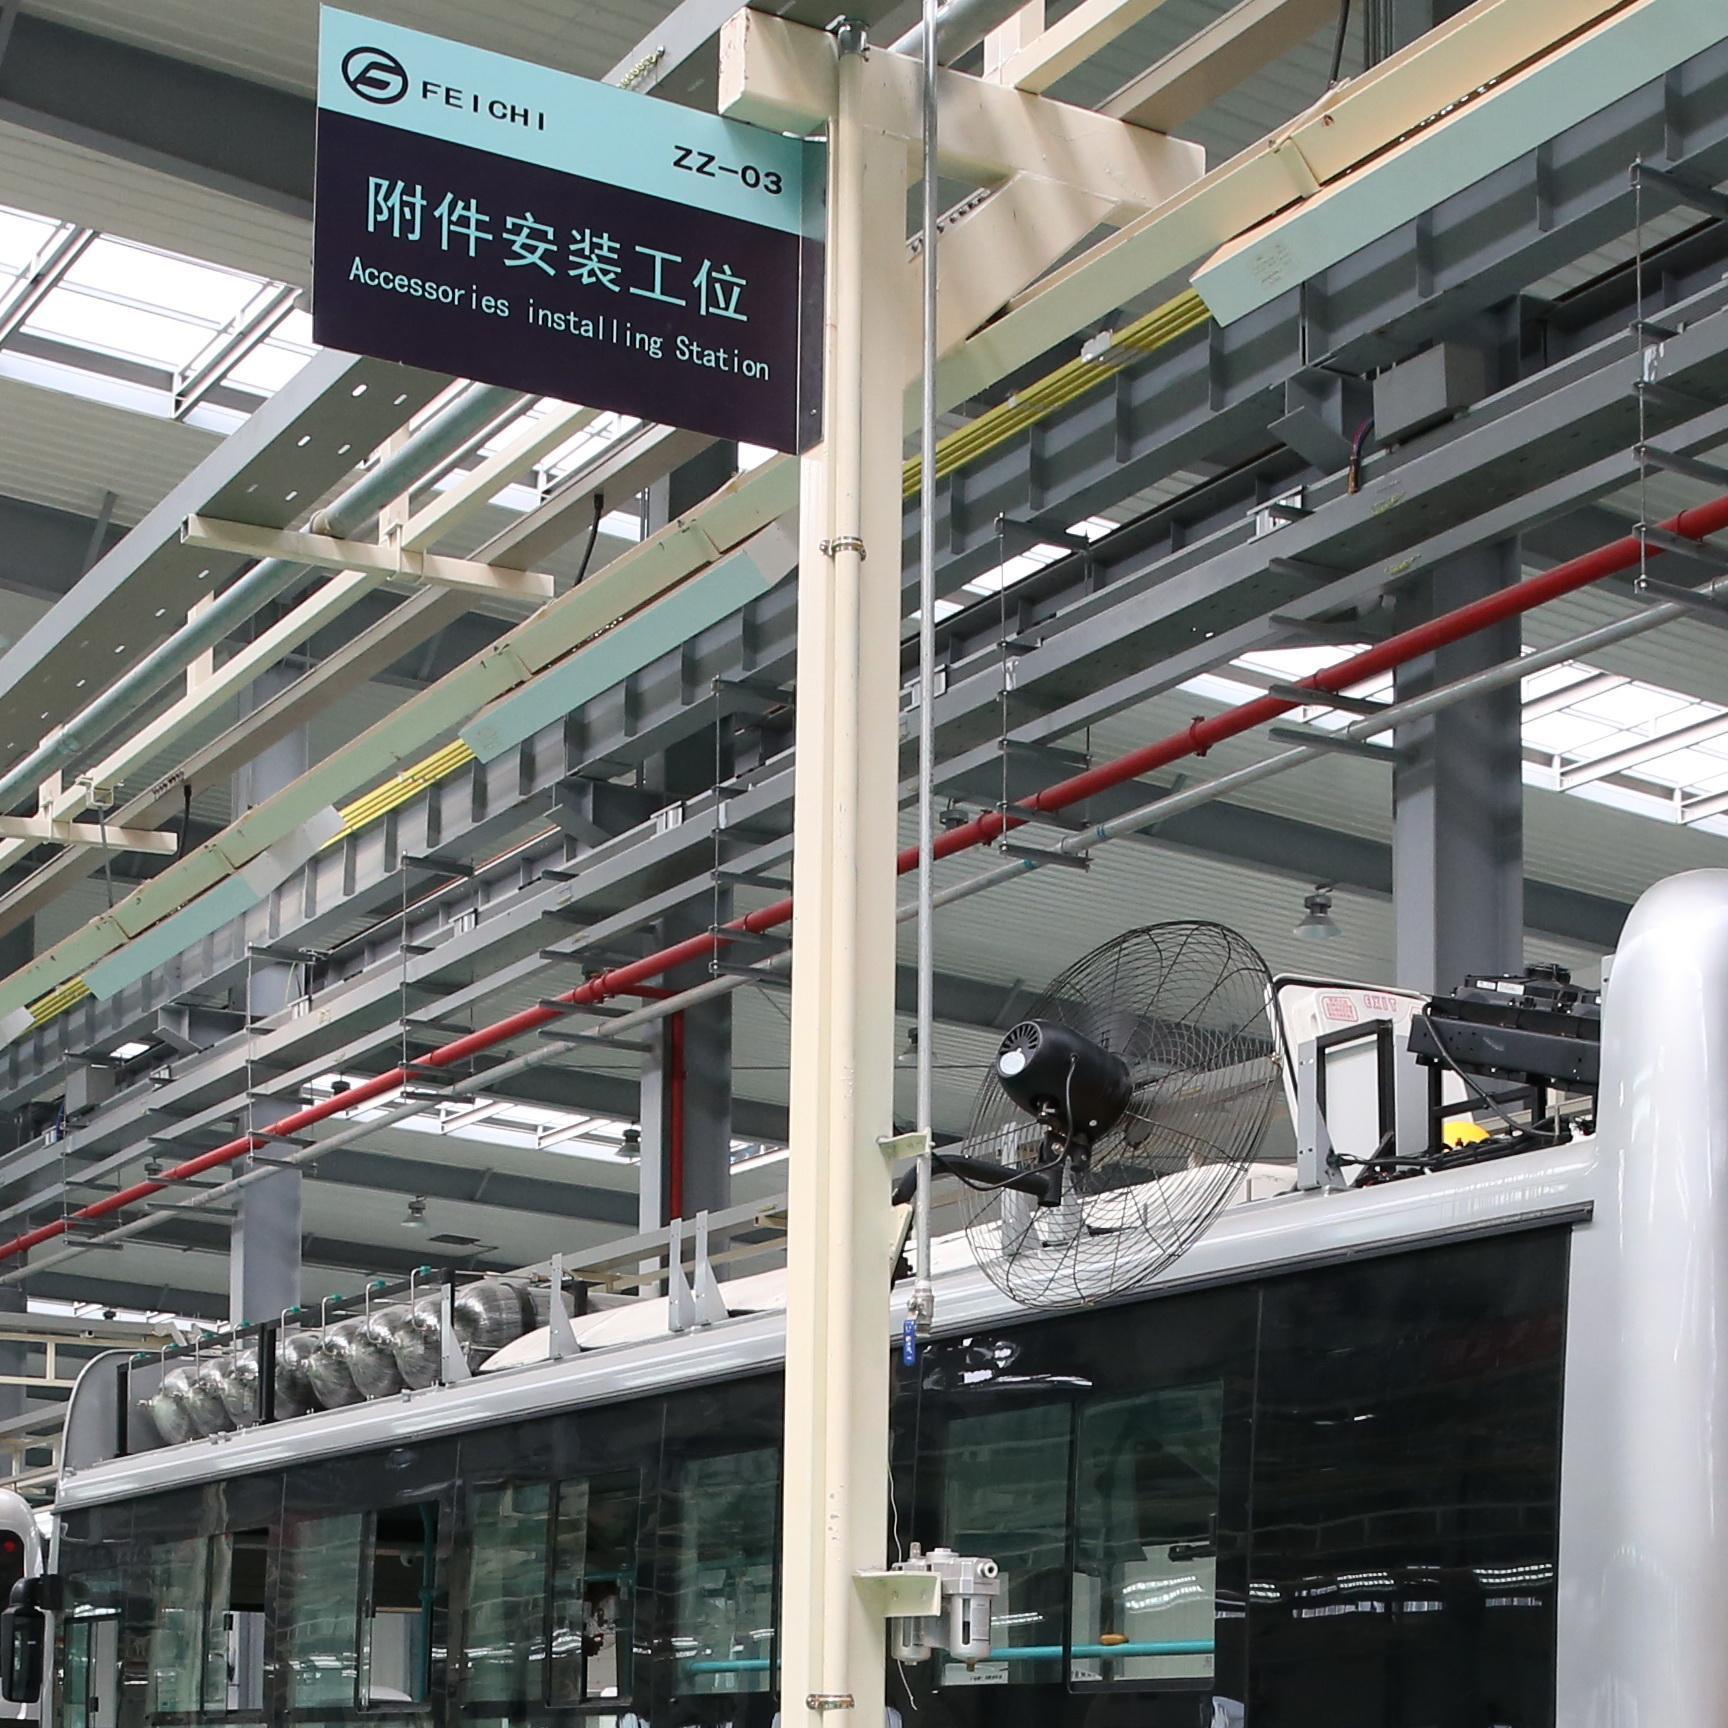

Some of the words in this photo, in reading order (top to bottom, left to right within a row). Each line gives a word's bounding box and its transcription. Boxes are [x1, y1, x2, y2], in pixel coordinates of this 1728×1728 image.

[422, 81, 545, 131] FEICHI
[673, 145, 784, 195] ZZ-03
[367, 176, 749, 322] 附件安装工位
[349, 256, 510, 317] Accessories
[528, 301, 663, 359] installing
[676, 336, 770, 381] Station
